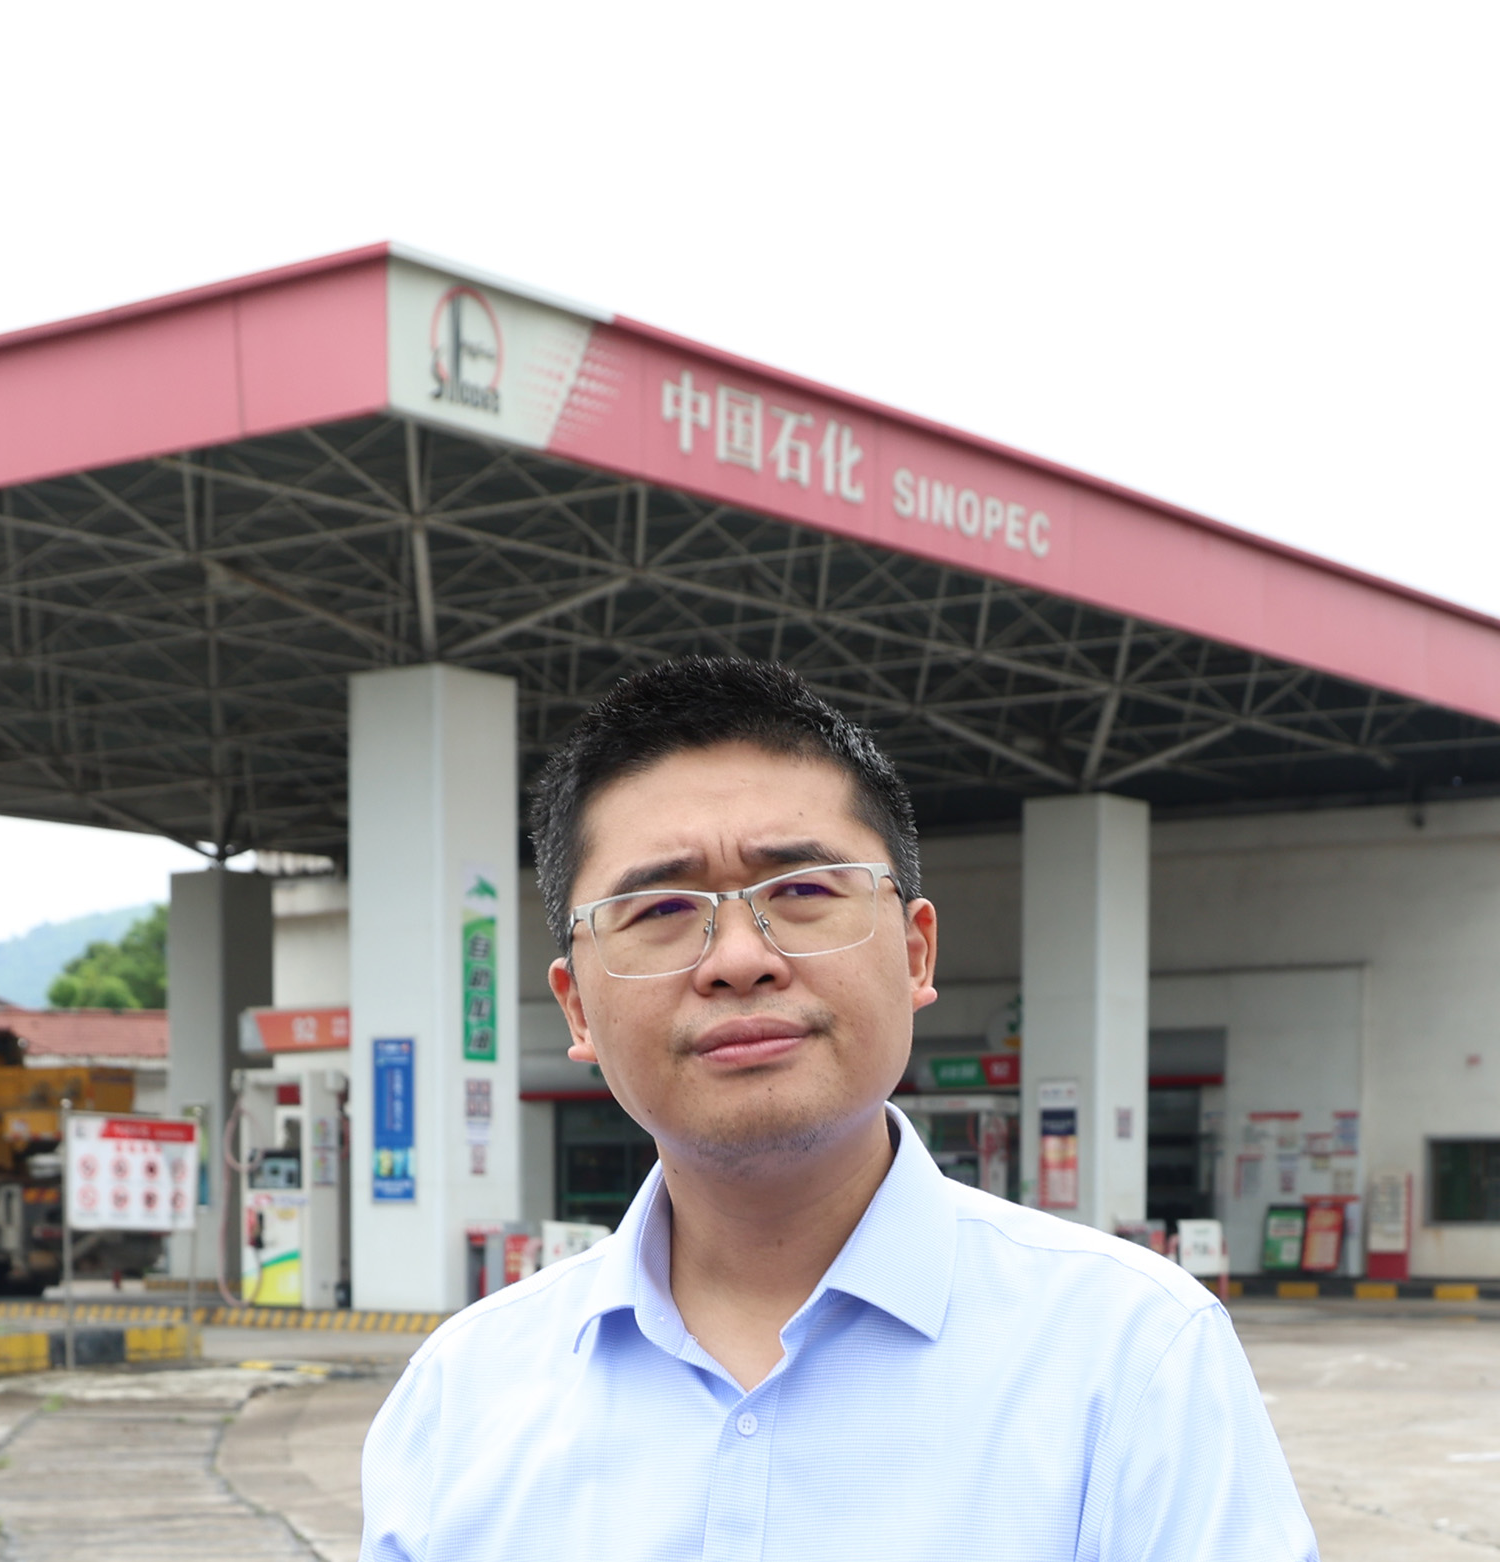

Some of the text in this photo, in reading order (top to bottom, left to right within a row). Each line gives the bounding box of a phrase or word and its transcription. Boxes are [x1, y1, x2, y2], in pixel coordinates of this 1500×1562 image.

[660, 368, 1052, 560] 中国石化 SINOPEC
